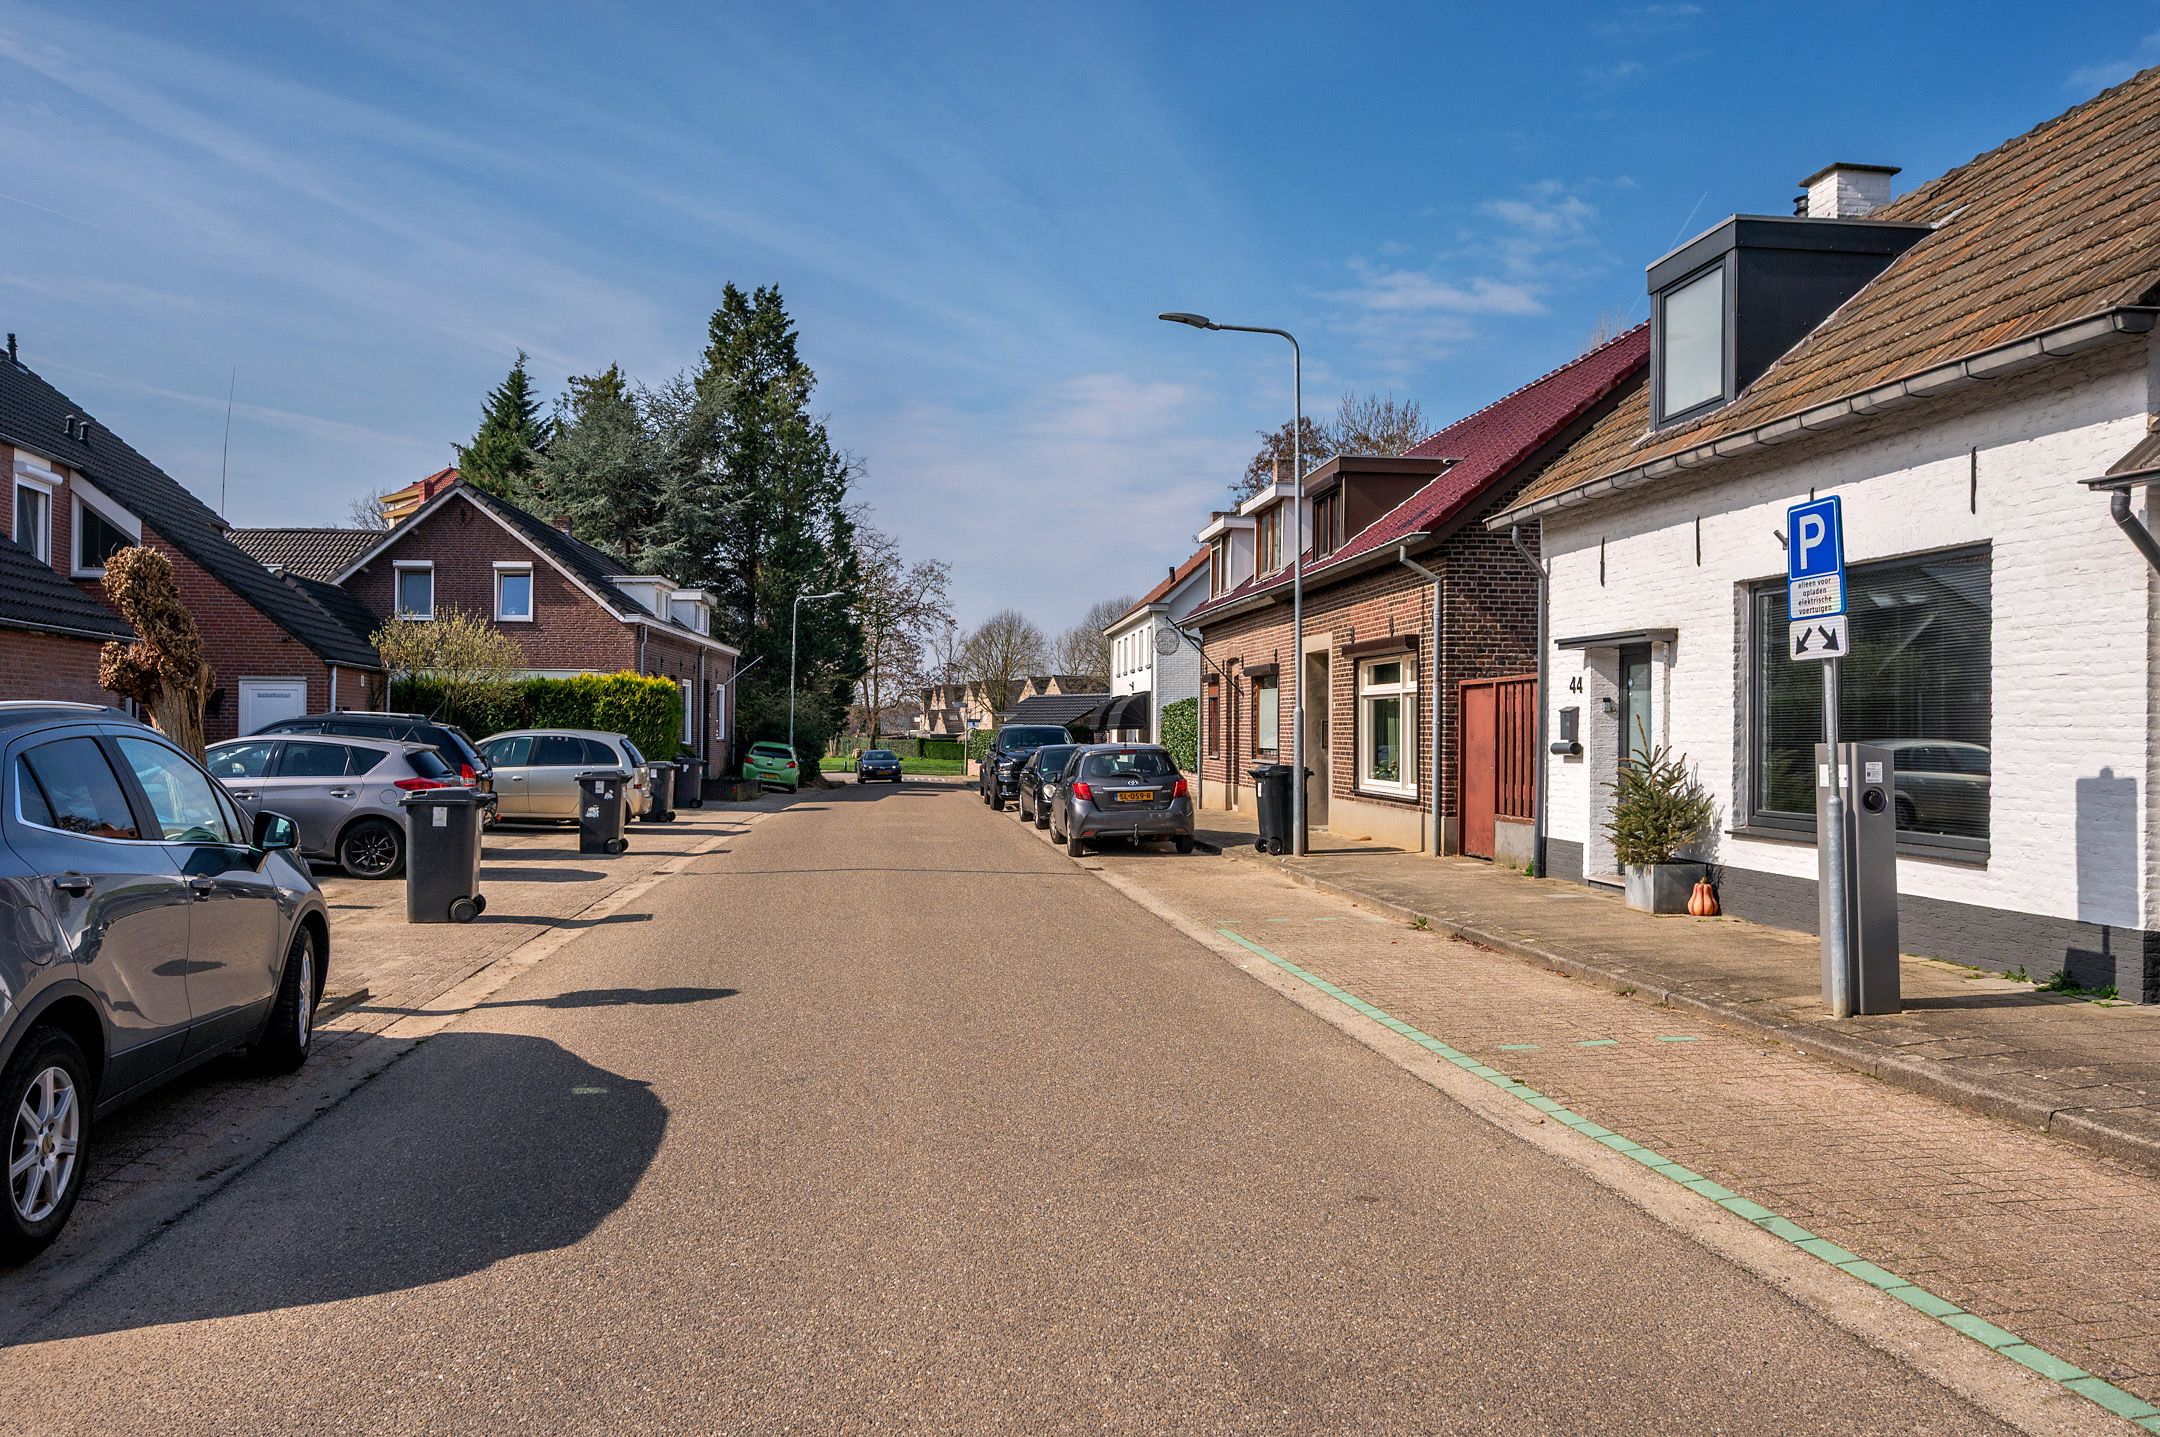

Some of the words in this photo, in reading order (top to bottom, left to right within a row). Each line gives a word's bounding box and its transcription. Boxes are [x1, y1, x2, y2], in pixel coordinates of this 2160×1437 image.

[1799, 513, 1826, 570] P
[1798, 580, 1816, 589] alleen
[1817, 578, 1831, 586] voor
[1803, 587, 1827, 597] opladen
[1798, 595, 1832, 606] elektrische
[1569, 676, 1583, 694] 44
